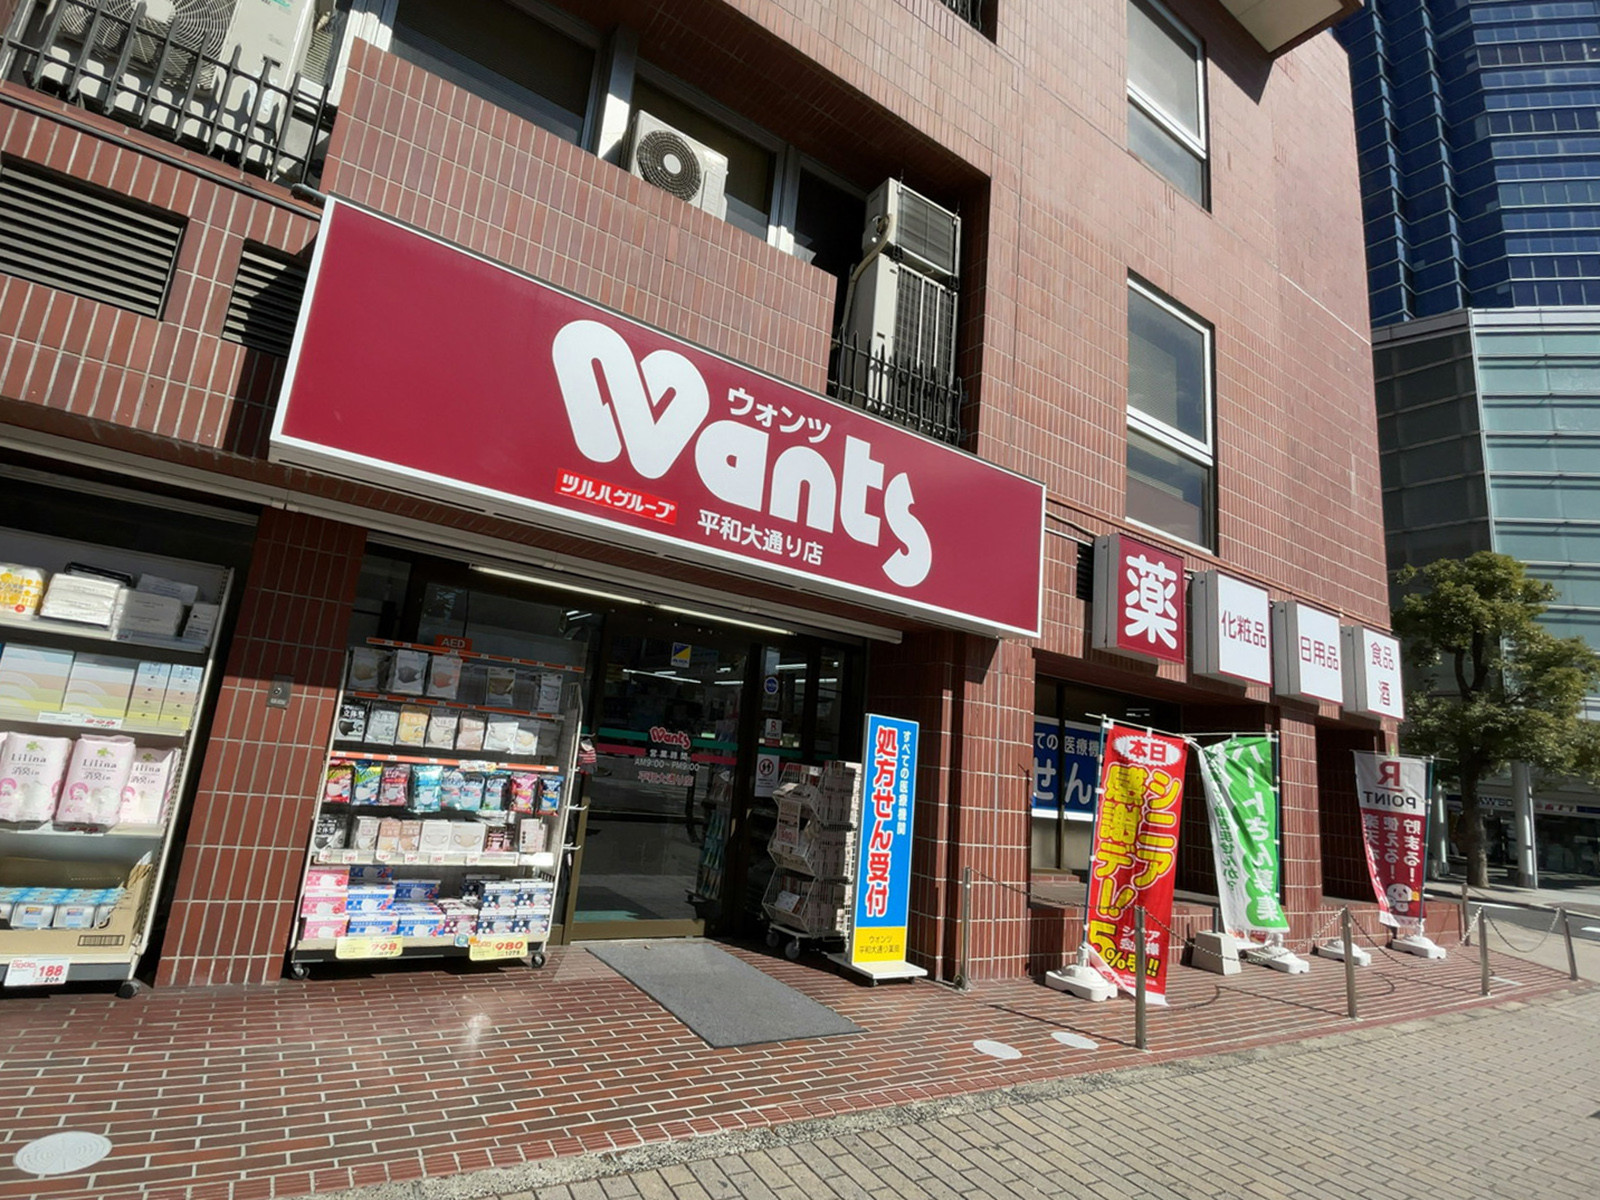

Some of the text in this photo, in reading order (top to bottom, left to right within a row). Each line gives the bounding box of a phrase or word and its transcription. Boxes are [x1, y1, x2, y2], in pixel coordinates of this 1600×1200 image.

[552, 319, 932, 588] Wants
[560, 473, 675, 518] ツルハグループ
[696, 508, 824, 566] 平和大通り店
[1125, 554, 1178, 650] 薬
[1221, 610, 1267, 648] 化粧品
[441, 638, 466, 650] AED
[1300, 635, 1339, 671] 日用品
[1371, 641, 1394, 671] 食品
[650, 726, 692, 750] Wants
[1128, 739, 1167, 763] 本日
[11, 753, 47, 763] Lilina
[82, 758, 117, 769] Lilina
[866, 725, 898, 918] 処方せん受付
[371, 943, 397, 952] 798
[495, 941, 523, 951] 980
[39, 965, 64, 977] 188
